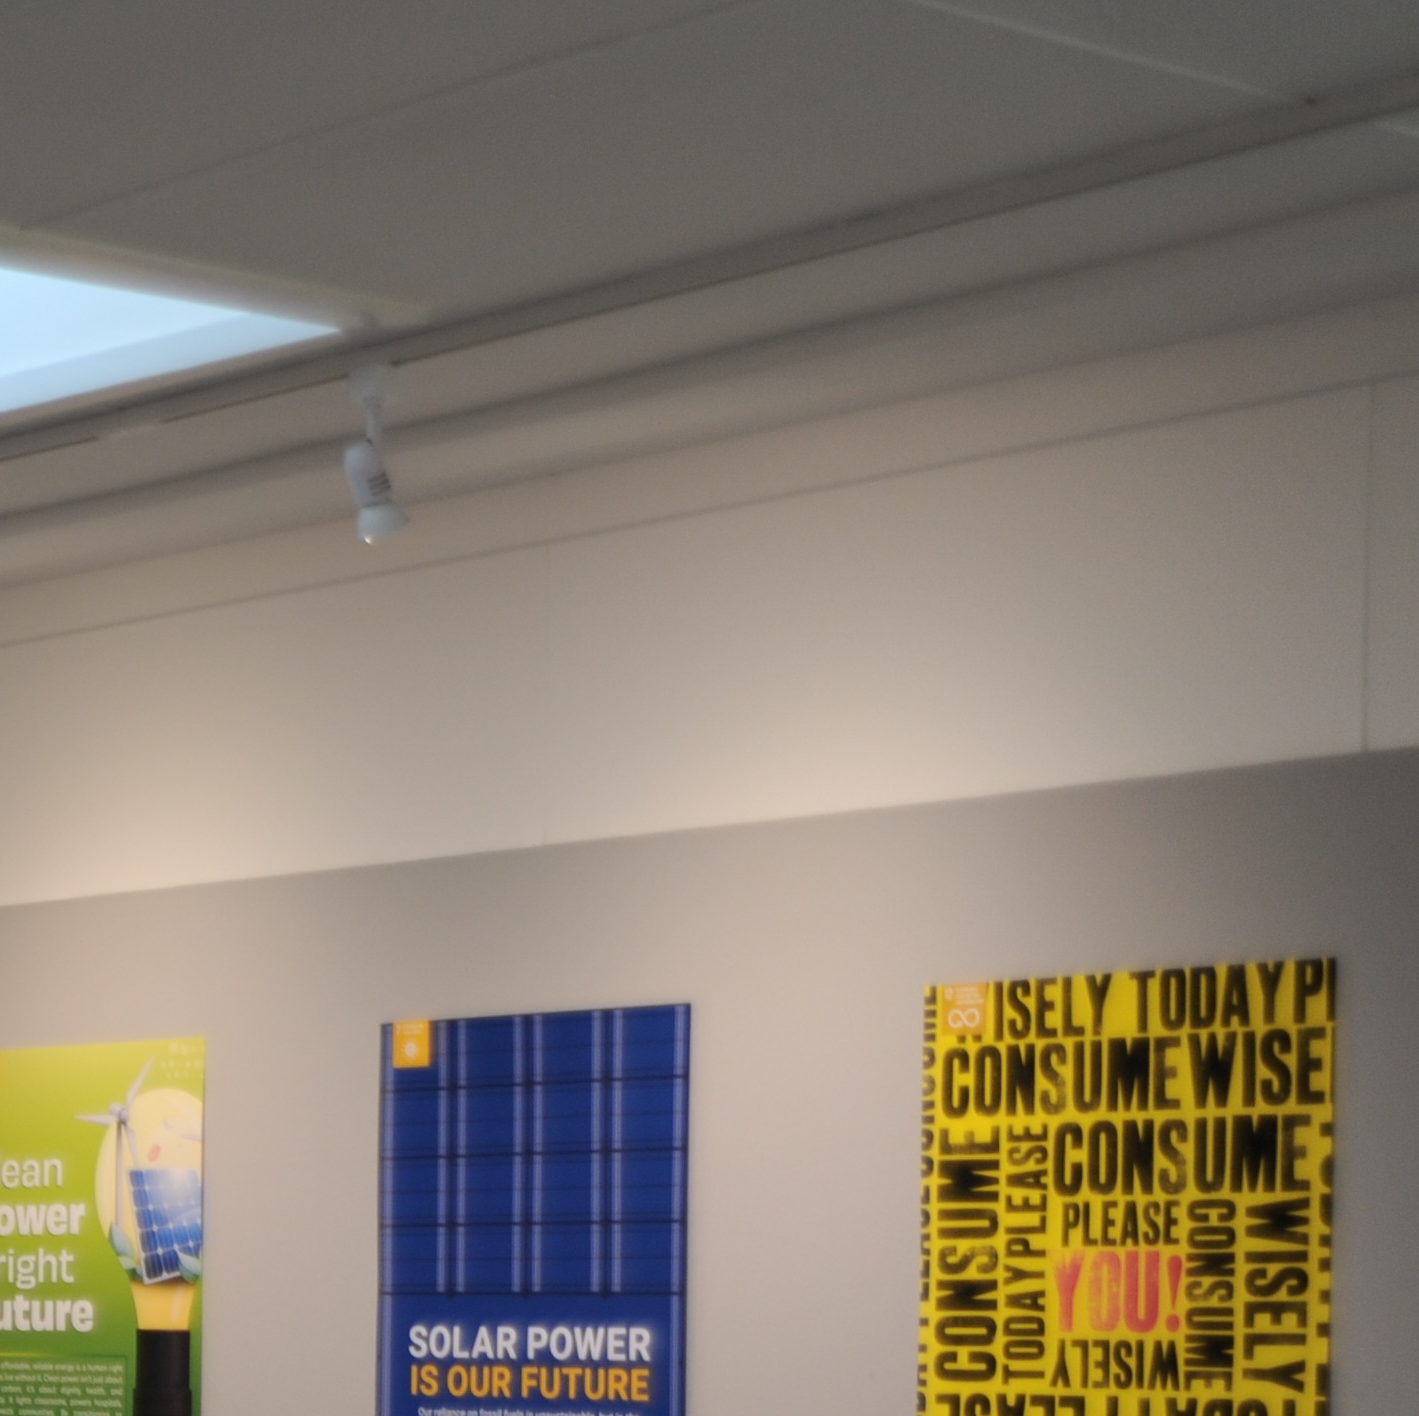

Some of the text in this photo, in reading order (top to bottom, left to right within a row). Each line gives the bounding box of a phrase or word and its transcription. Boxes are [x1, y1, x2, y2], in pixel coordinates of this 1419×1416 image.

[956, 972, 1112, 1043] ISELY
[1129, 961, 1287, 1033] TODAY
[941, 1036, 1182, 1119] CONSUME
[1053, 1114, 1312, 1197] CONSUME
[933, 1125, 1001, 1383] CONSUME
[1002, 1123, 1049, 1385] PLEASE TODAY
[1062, 1200, 1181, 1247] PLEASE
[1056, 1249, 1183, 1333] YOU!
[1184, 1199, 1237, 1392] CONSUME
[1242, 1197, 1312, 1394] WISELY
[408, 1324, 651, 1362] SOLAR POWER
[410, 1365, 650, 1402] IS OUR FUTURE
[1050, 1337, 1181, 1391] WISELY
